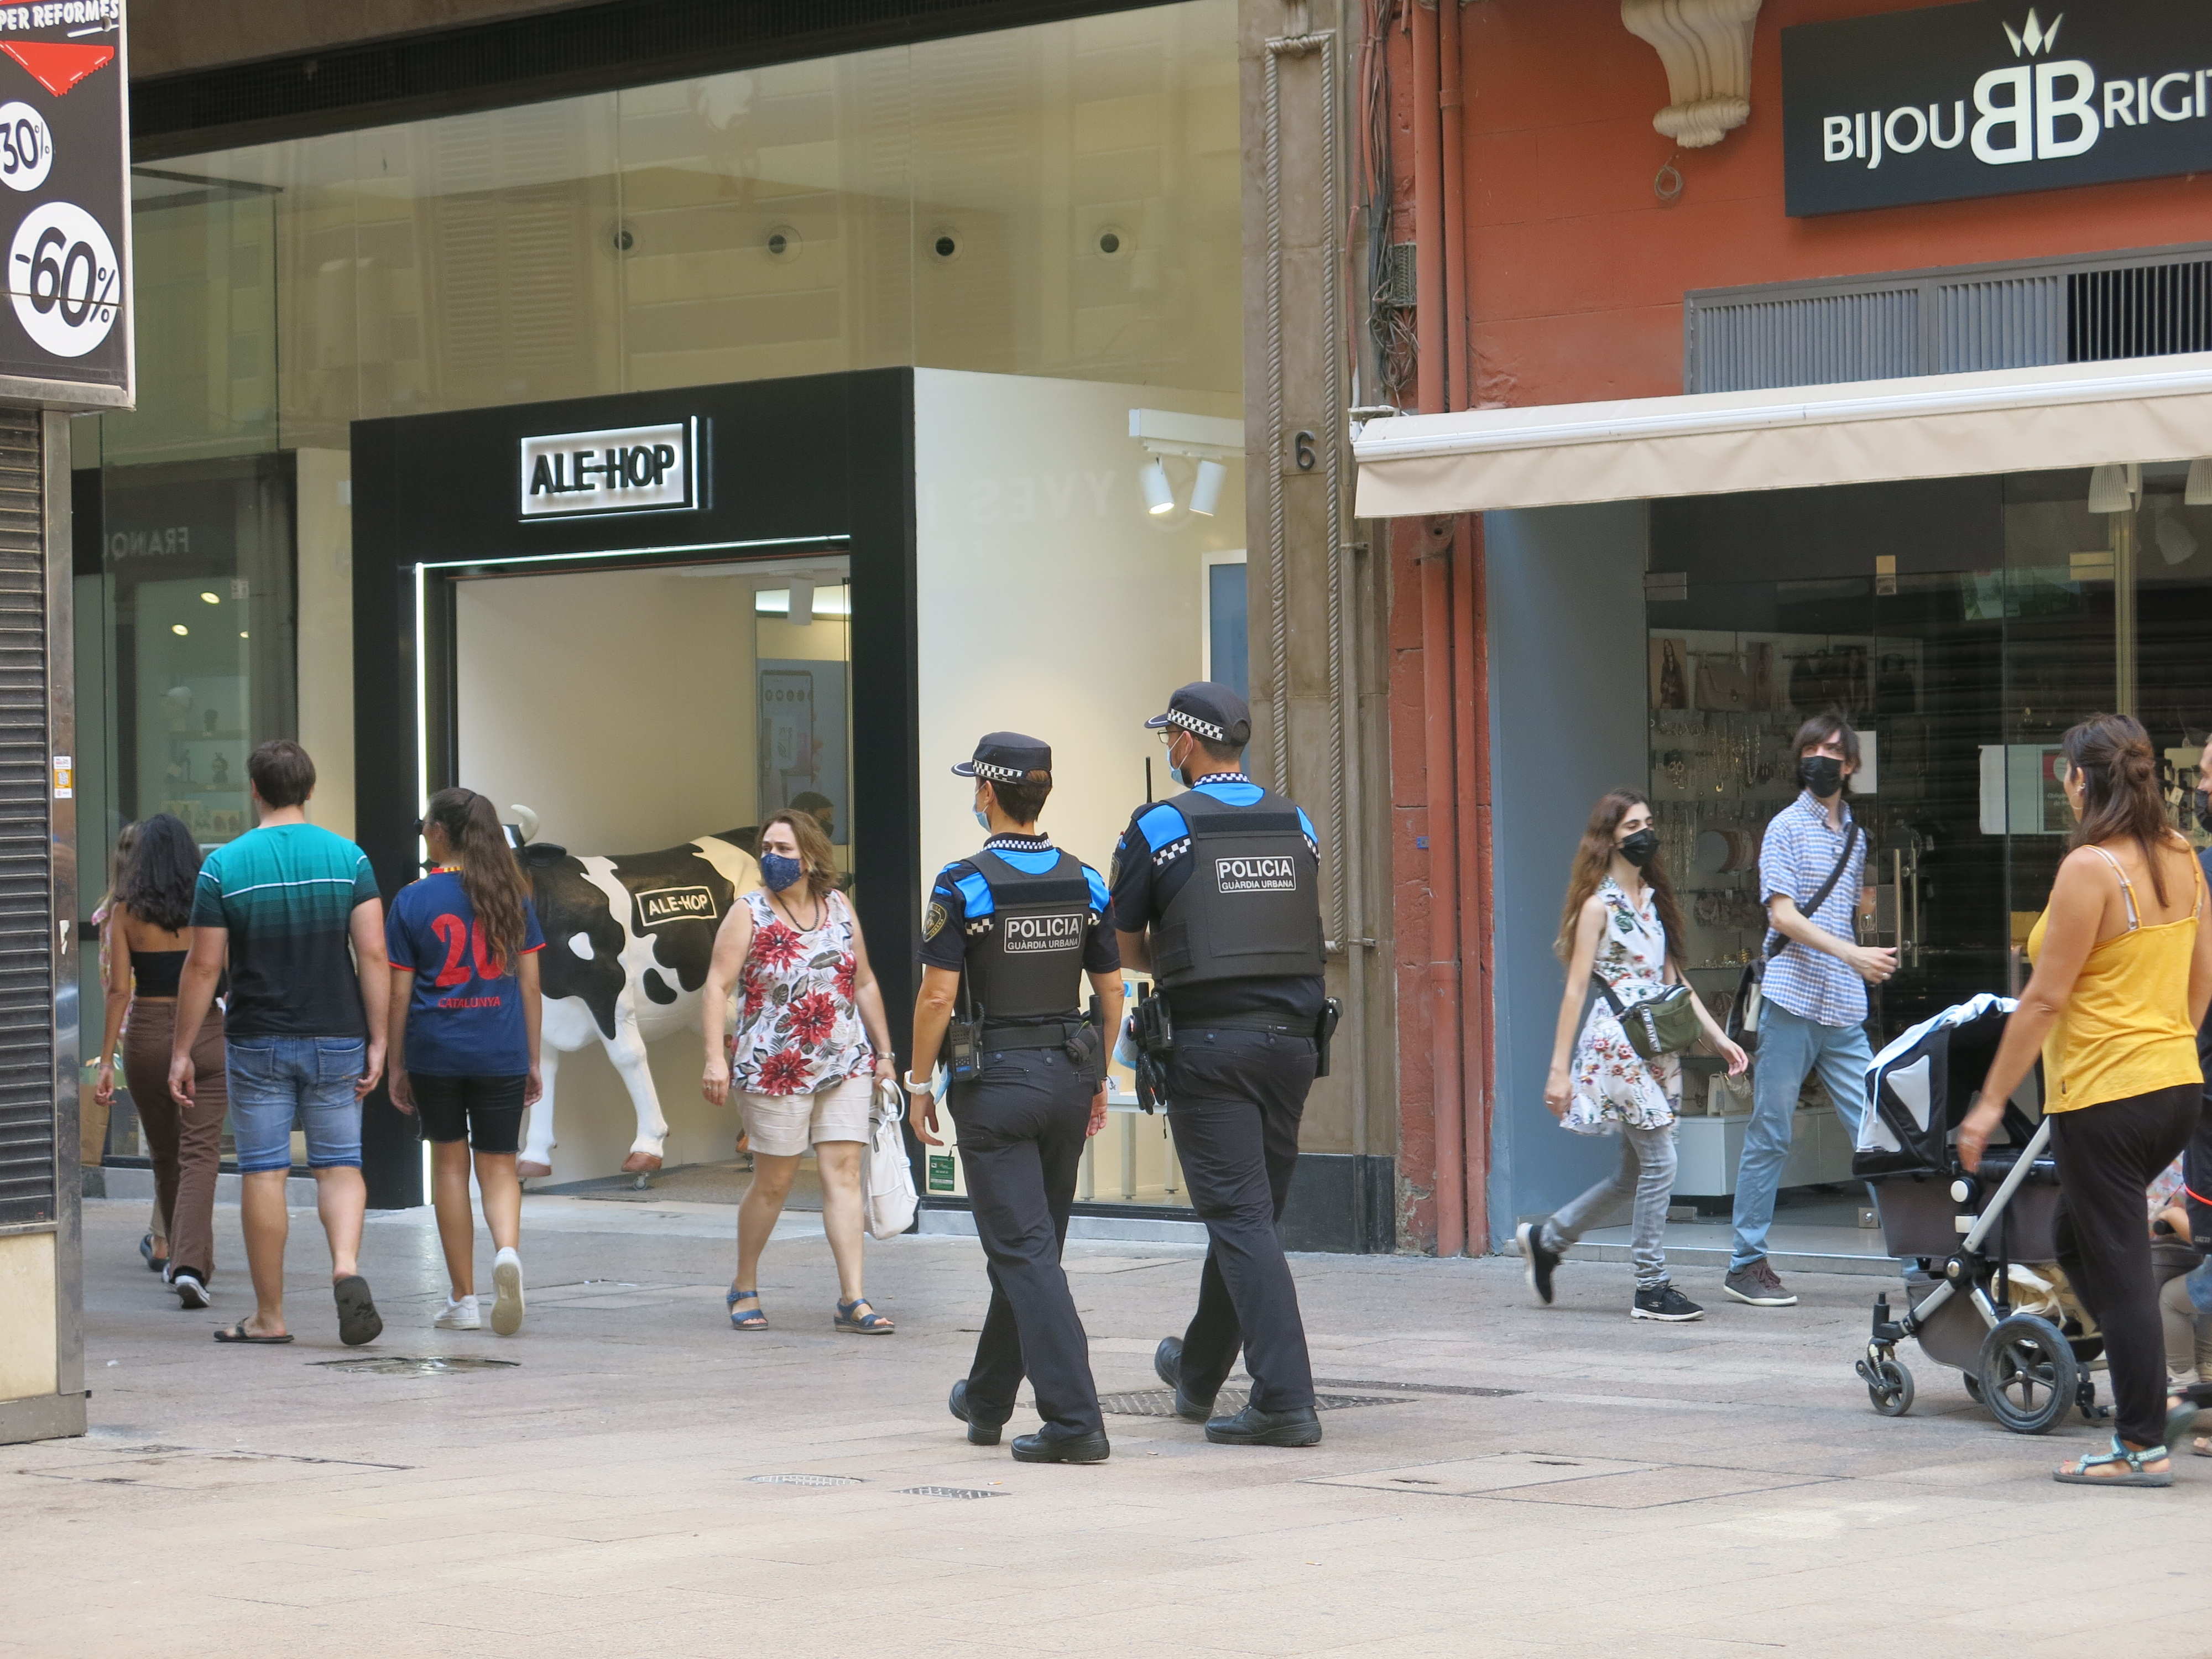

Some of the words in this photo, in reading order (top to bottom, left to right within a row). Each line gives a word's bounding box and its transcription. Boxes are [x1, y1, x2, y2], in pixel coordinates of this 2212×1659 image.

[32, 0, 118, 28] REFORMES
[1823, 100, 1964, 169] BIJOU
[15, 226, 116, 327] -60%
[1295, 430, 1315, 469] 6
[529, 444, 675, 495] ALE-HOP
[1219, 859, 1292, 879] POLICIA
[1222, 879, 1260, 890] GUÀRDIA
[1261, 880, 1293, 888] URBANA
[649, 894, 708, 916] ALE-HOP
[1008, 917, 1079, 939] POLICIA
[1008, 939, 1047, 950] GUÀRDIA
[1048, 938, 1078, 948] URBANA
[437, 996, 502, 1008] CATALUNYA
